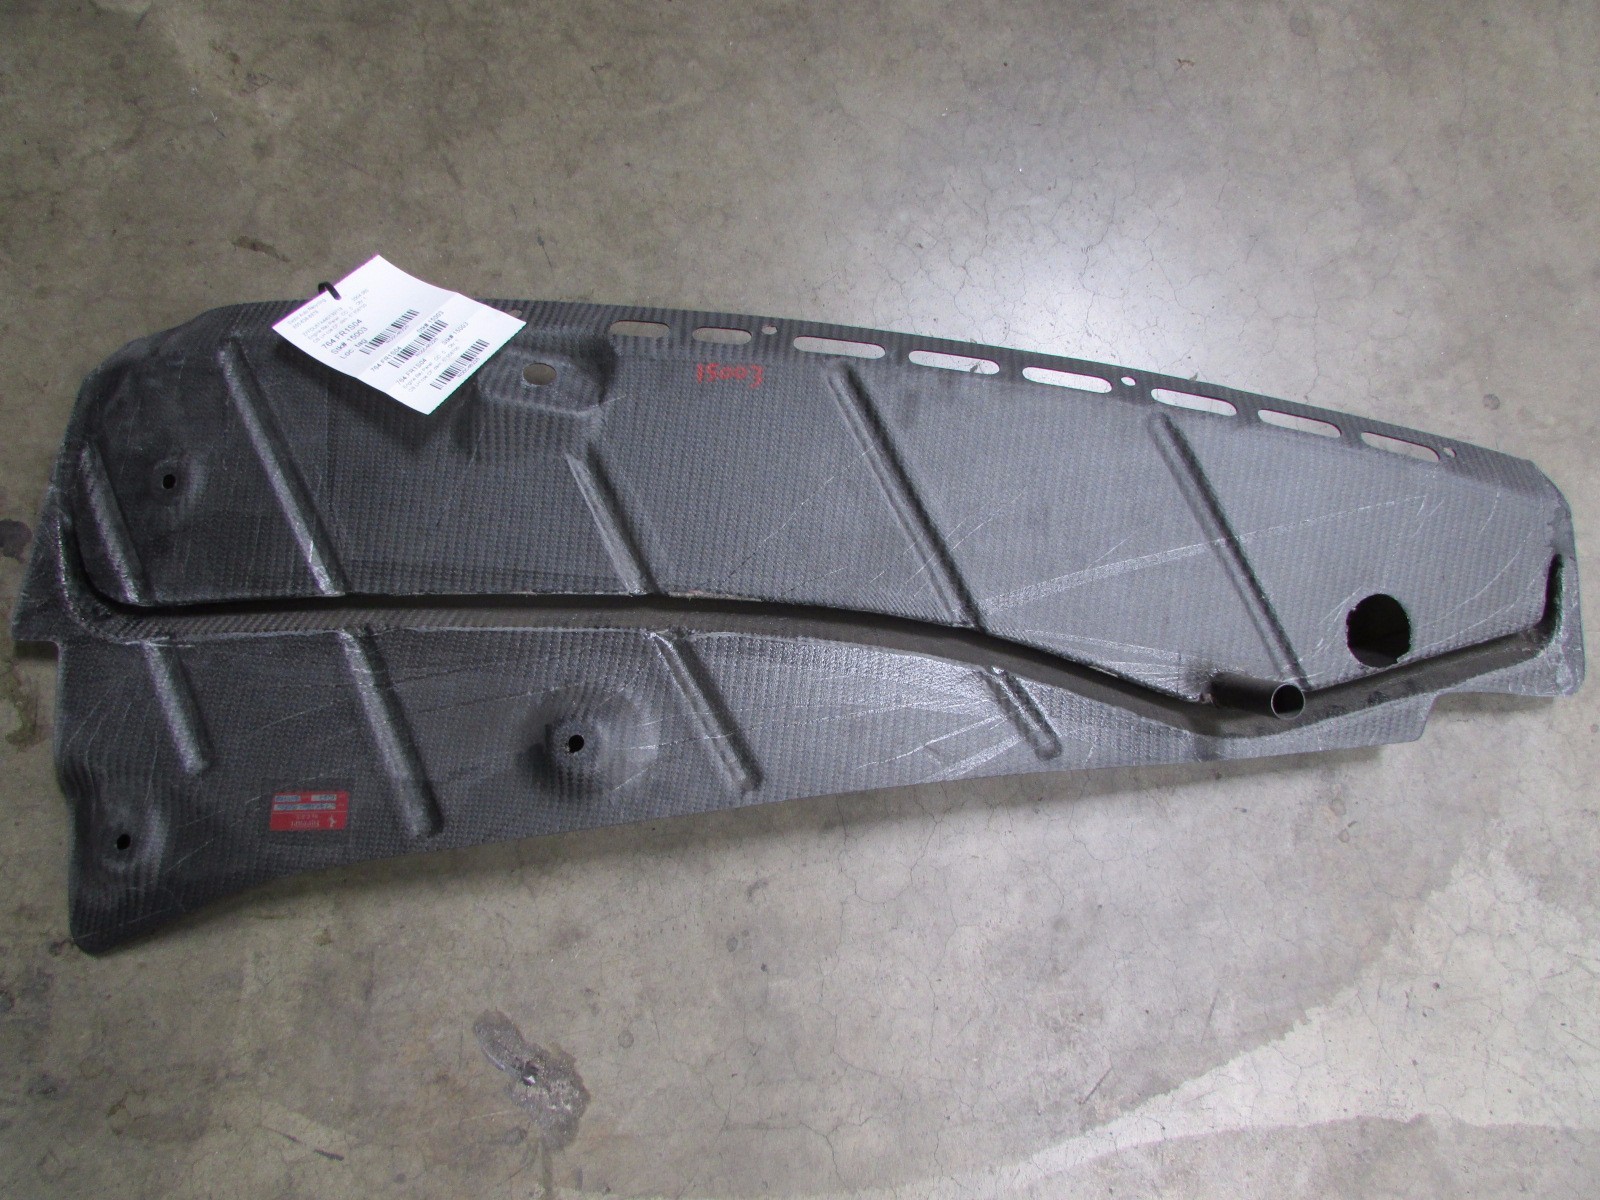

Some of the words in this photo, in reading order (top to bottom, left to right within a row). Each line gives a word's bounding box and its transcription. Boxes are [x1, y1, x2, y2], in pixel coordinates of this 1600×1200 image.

[344, 325, 369, 343] 15003
[353, 337, 369, 349] tag
[697, 362, 765, 389] 15003
